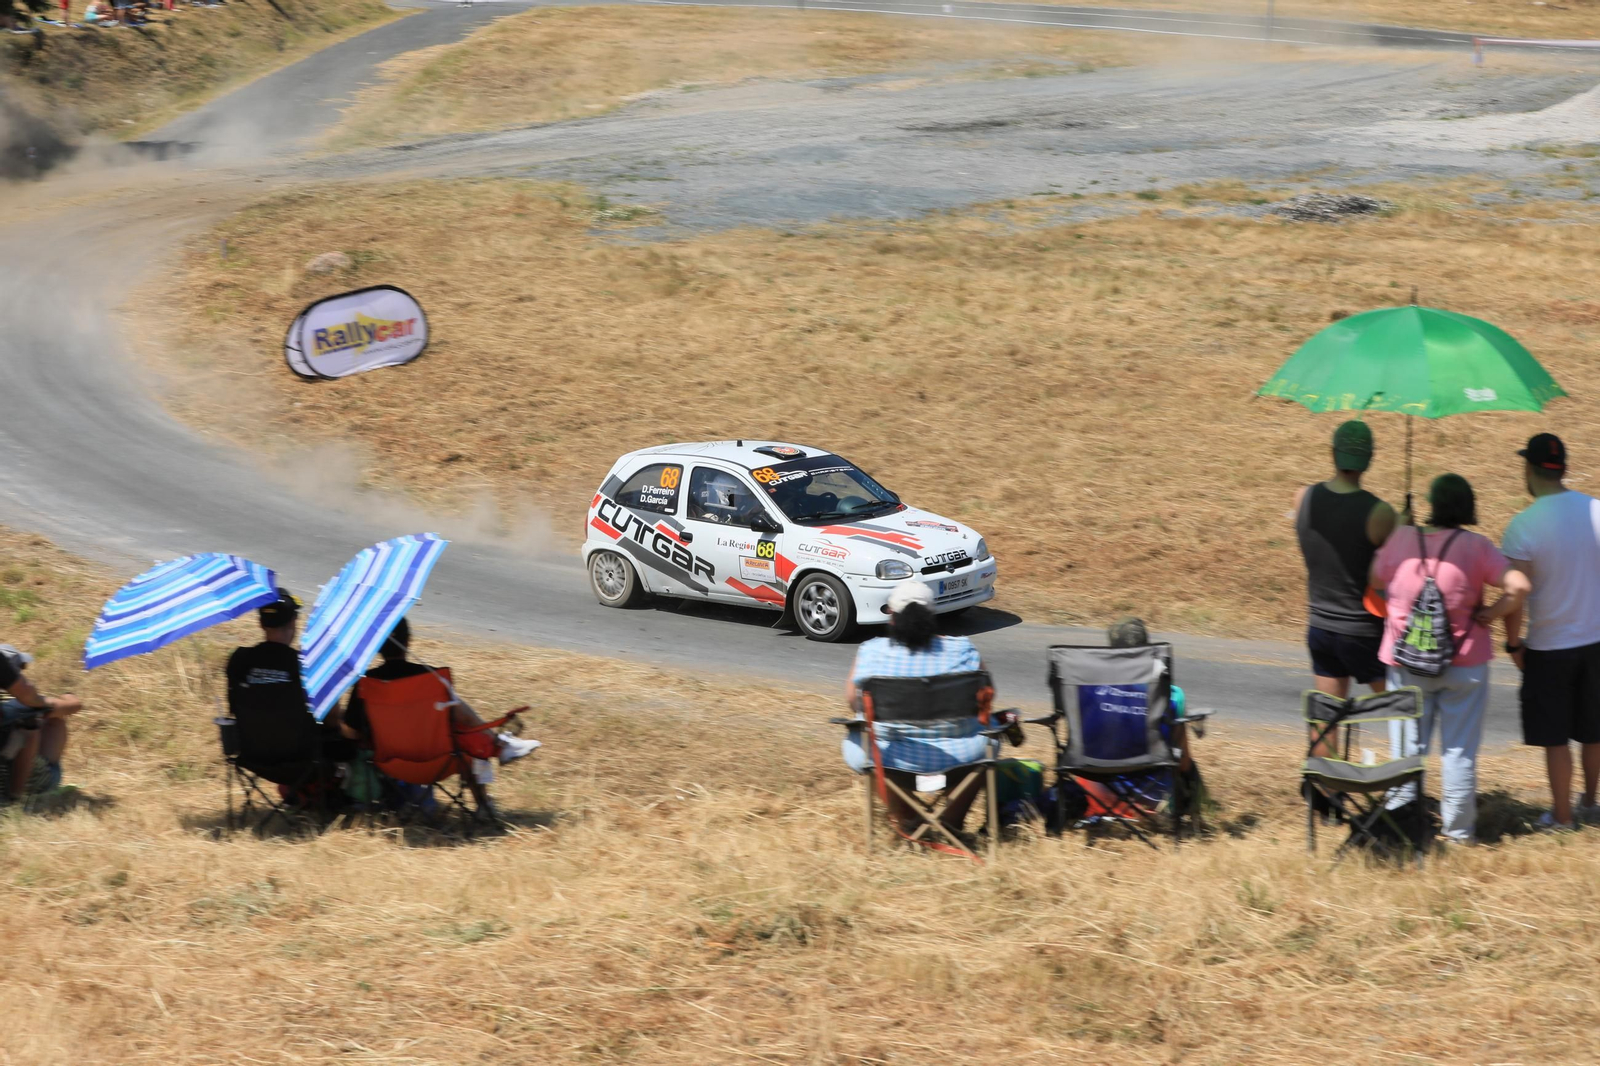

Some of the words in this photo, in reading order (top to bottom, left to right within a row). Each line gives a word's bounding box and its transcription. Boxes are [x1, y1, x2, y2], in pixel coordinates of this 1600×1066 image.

[312, 317, 417, 350] Rallycar
[660, 467, 679, 489] 68
[752, 467, 780, 483] 68
[641, 485, 675, 496] D.Ferreiro
[640, 494, 668, 505] D.García
[598, 498, 716, 585] CUTGAR
[717, 537, 728, 547] La
[757, 541, 775, 559] 68
[798, 543, 847, 560] CUTGAR
[924, 549, 968, 566] CUTGAR
